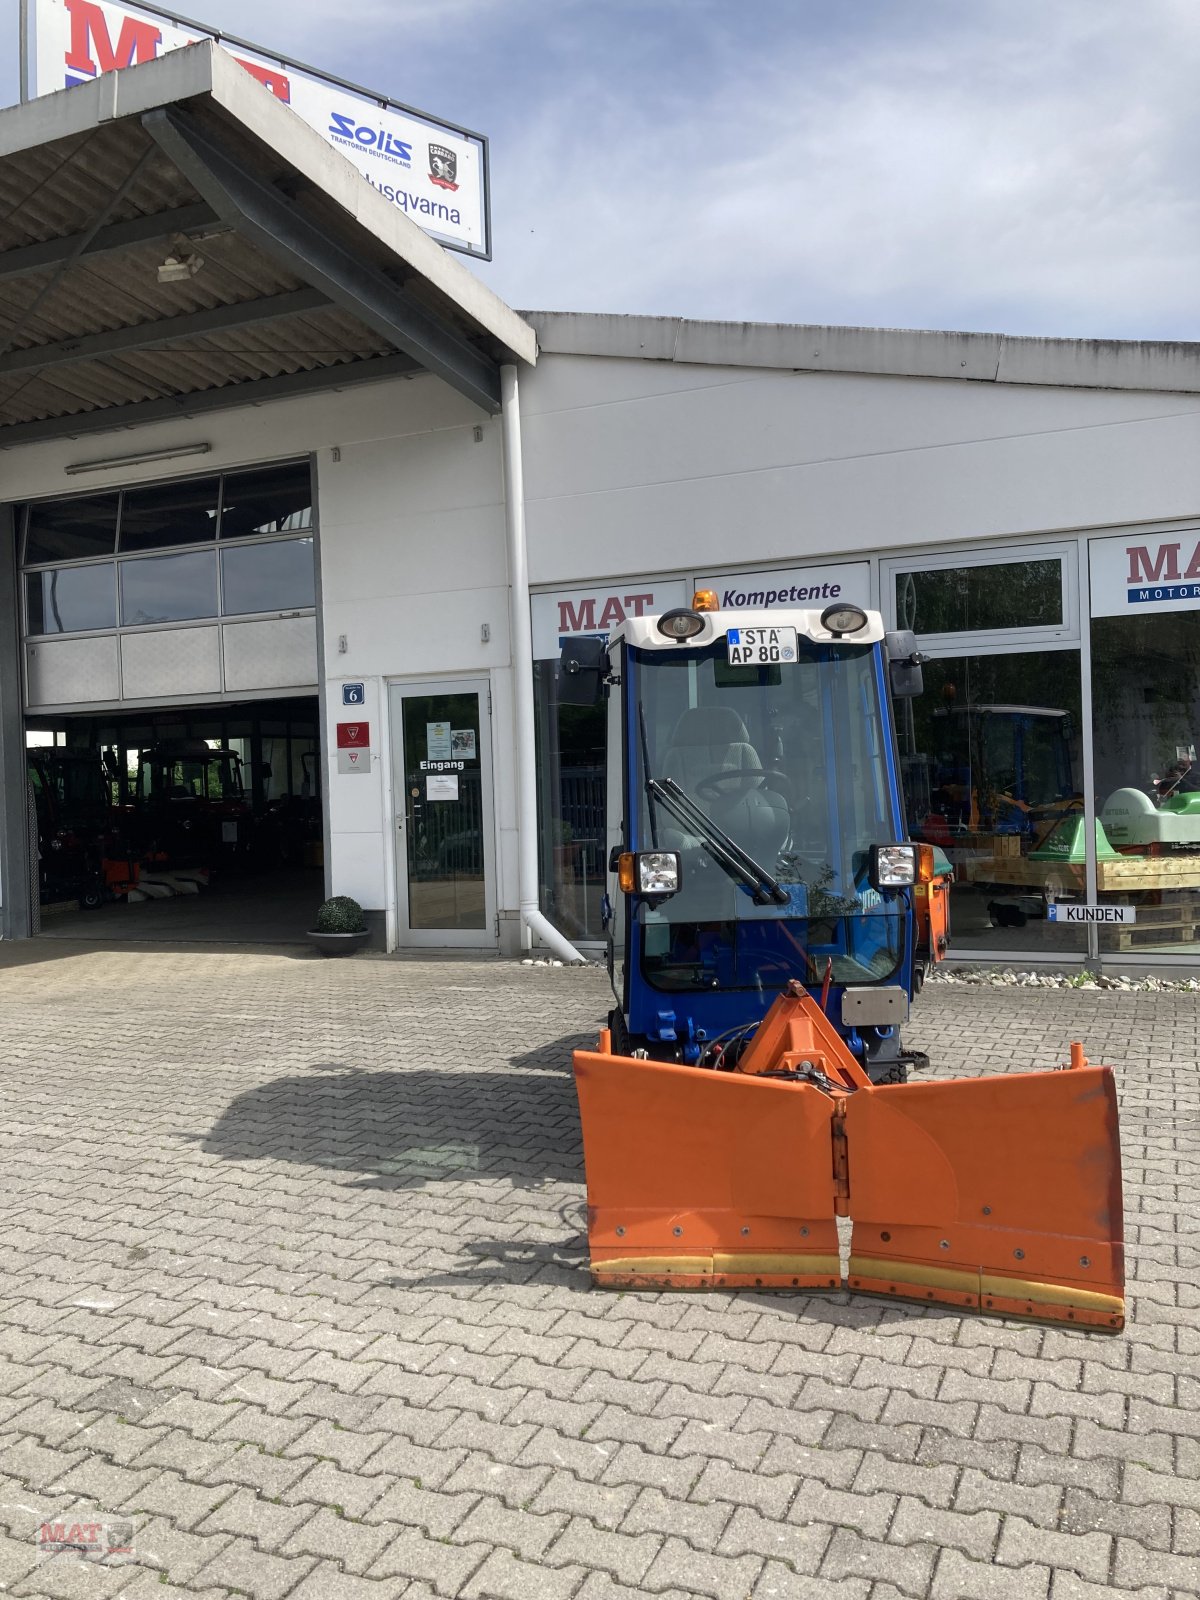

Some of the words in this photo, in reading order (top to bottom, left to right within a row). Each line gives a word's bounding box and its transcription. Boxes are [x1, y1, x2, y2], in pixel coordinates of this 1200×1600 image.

[328, 112, 412, 161] Solis
[330, 134, 368, 153] TRAKTOREN
[368, 148, 411, 169] DEUTSCHLAND
[722, 582, 841, 609] Kompetente
[557, 593, 654, 632] MAT
[745, 629, 779, 645] STA
[731, 646, 753, 663] AP
[758, 646, 780, 662] 80
[349, 689, 358, 702] 6
[419, 760, 465, 771] Eingang
[1067, 907, 1124, 922] KUNDEN
